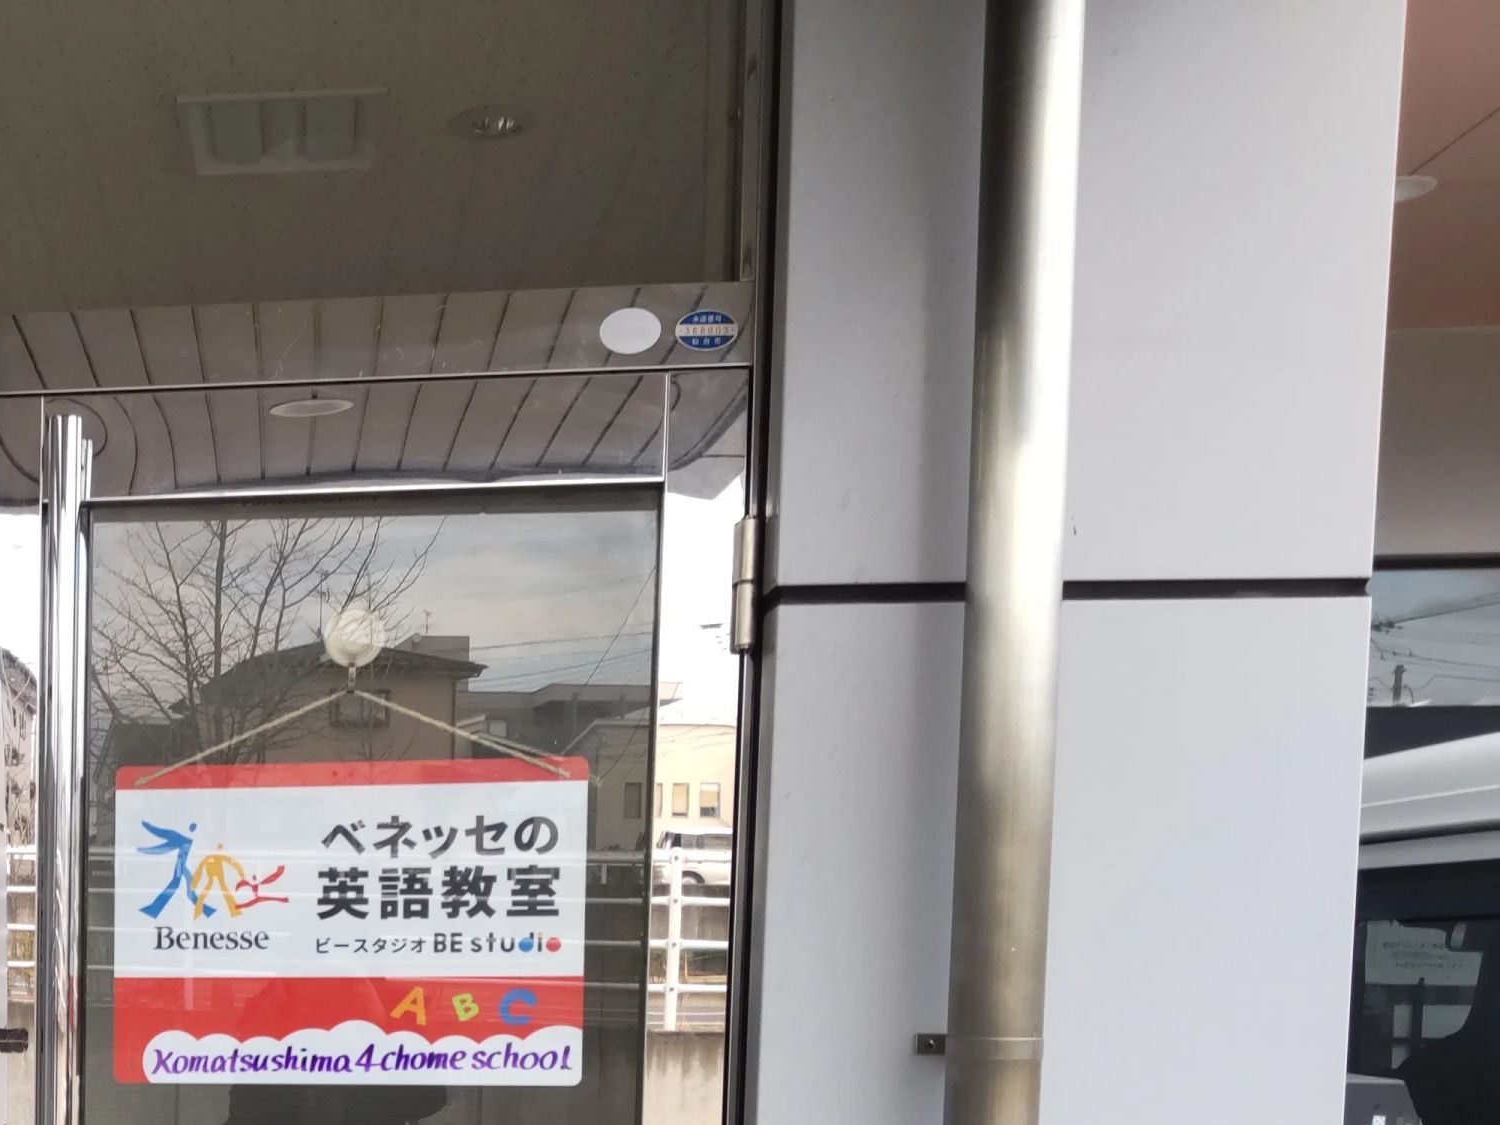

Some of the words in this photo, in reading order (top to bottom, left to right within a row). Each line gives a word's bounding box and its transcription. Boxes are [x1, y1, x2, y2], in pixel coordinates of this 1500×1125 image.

[321, 814, 560, 859] ベネッセの
[316, 866, 561, 920] 英語教室
[154, 926, 270, 951] Benesse
[315, 937, 426, 954] ビースタジオ
[433, 932, 463, 953] BE
[471, 932, 562, 953] studio
